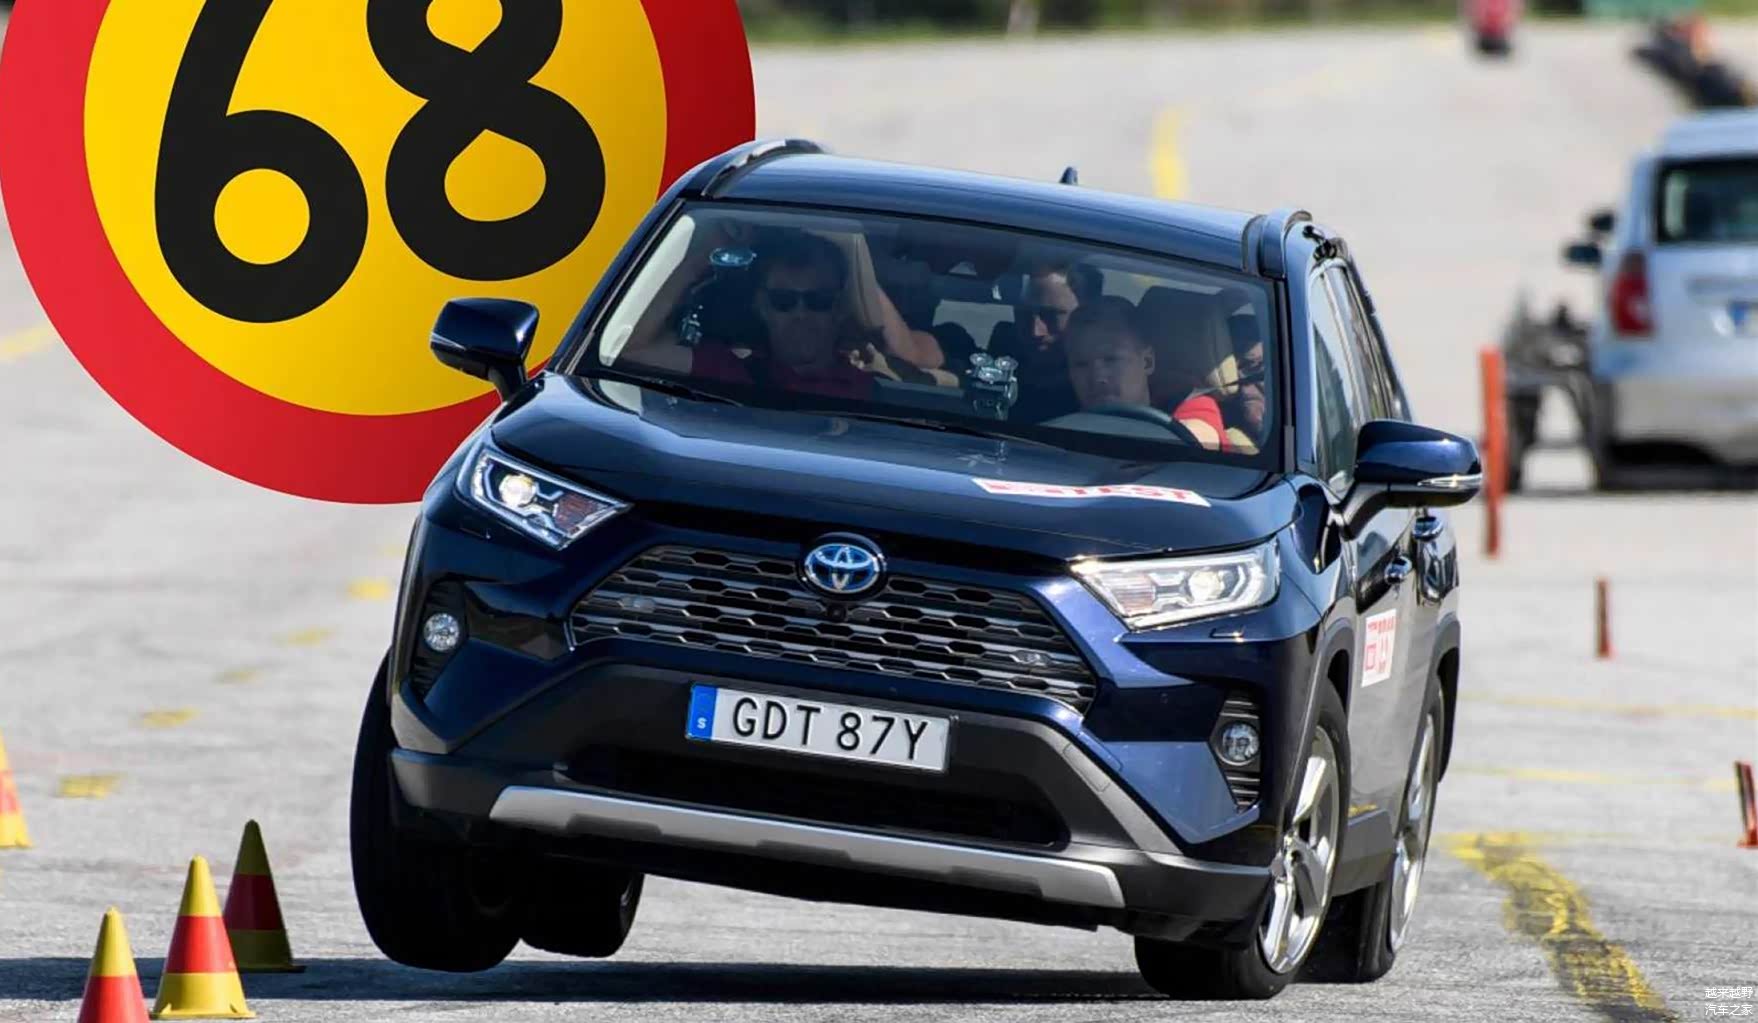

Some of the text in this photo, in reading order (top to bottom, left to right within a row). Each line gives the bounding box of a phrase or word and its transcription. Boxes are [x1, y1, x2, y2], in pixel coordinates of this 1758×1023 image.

[155, 0, 607, 323] 68
[696, 717, 707, 729] S
[732, 696, 929, 760] GDT 87Y
